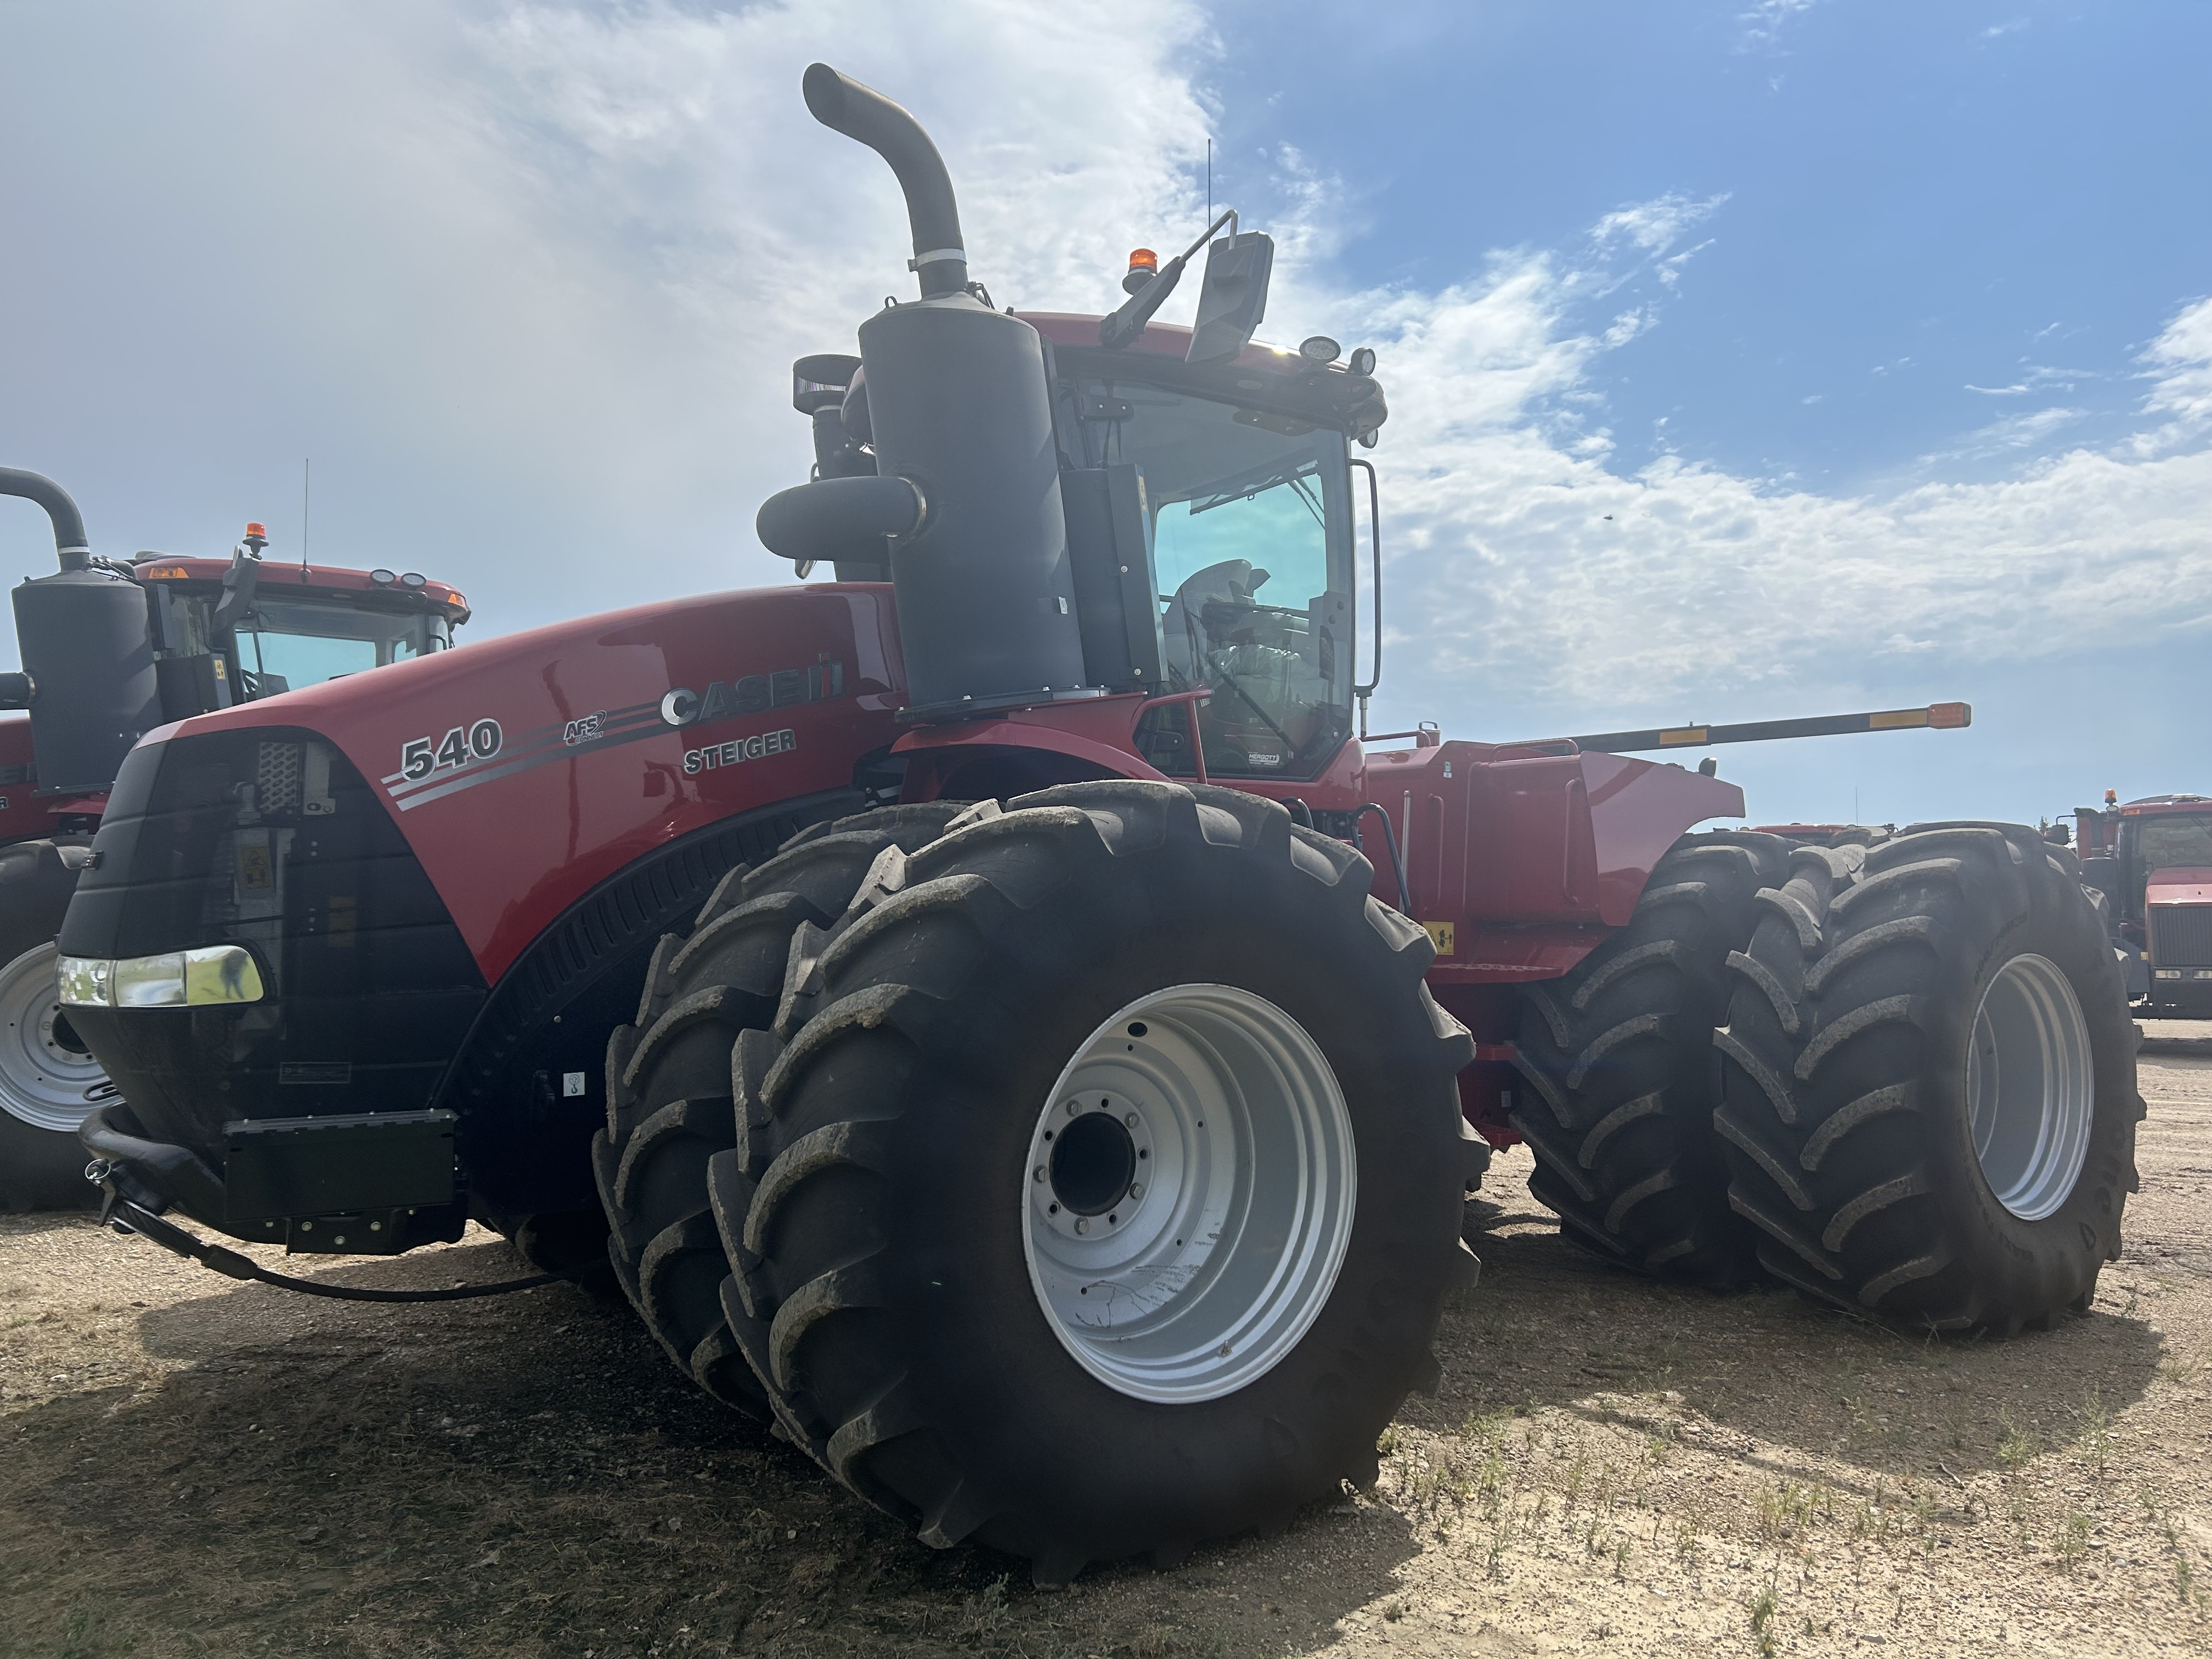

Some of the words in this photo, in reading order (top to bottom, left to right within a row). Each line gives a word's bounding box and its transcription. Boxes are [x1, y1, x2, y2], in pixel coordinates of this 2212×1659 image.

[563, 715, 599, 741] AFS
[575, 731, 603, 743] CONNECT
[401, 718, 503, 782] 540
[684, 729, 797, 775] STEIGER
